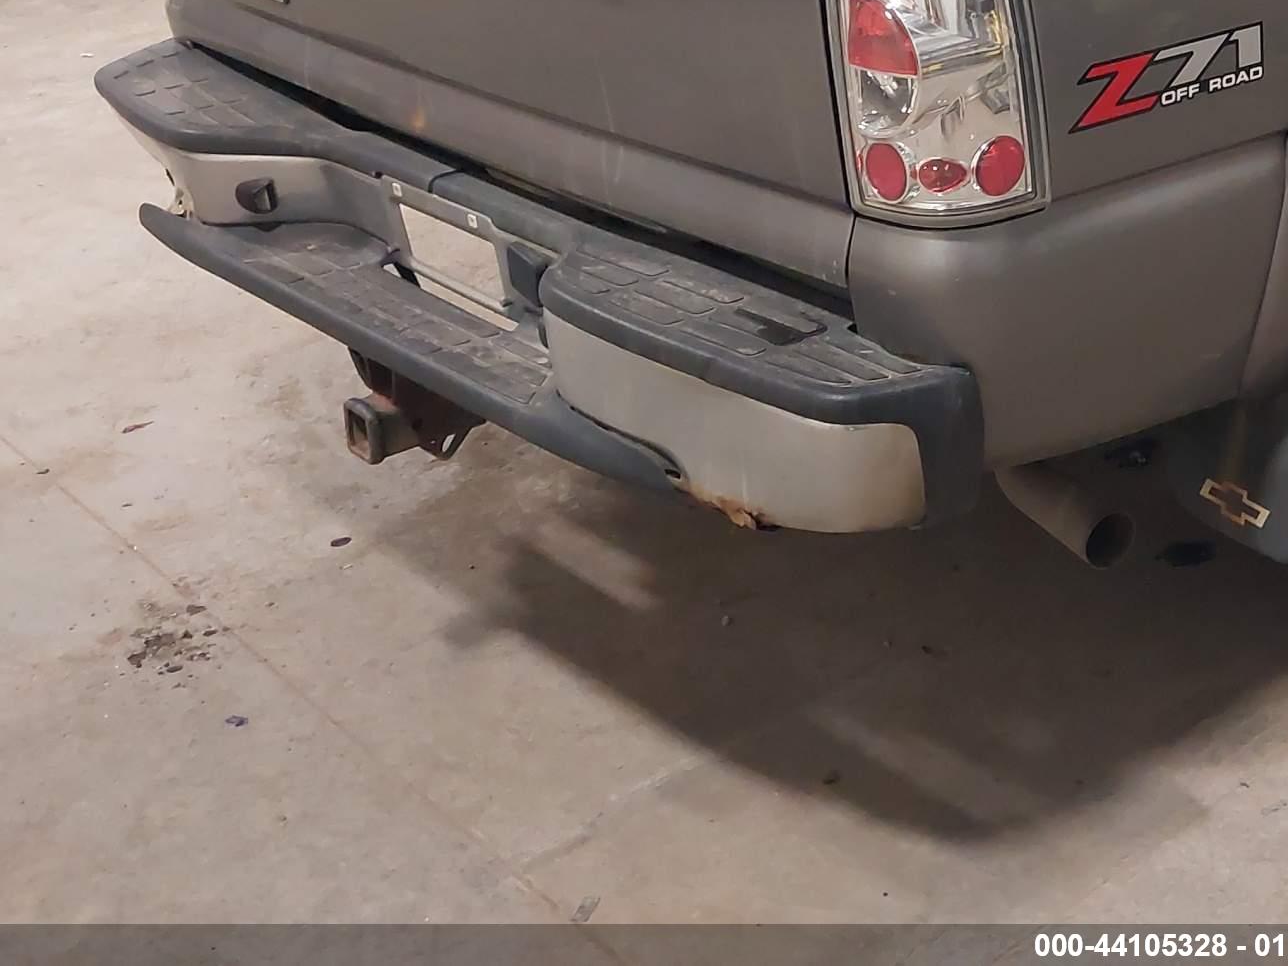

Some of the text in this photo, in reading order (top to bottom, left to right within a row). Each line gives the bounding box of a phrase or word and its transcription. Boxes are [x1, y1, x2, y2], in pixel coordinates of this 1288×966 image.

[1068, 21, 1263, 134] Z71
[1160, 66, 1264, 106] OFF ROAD
